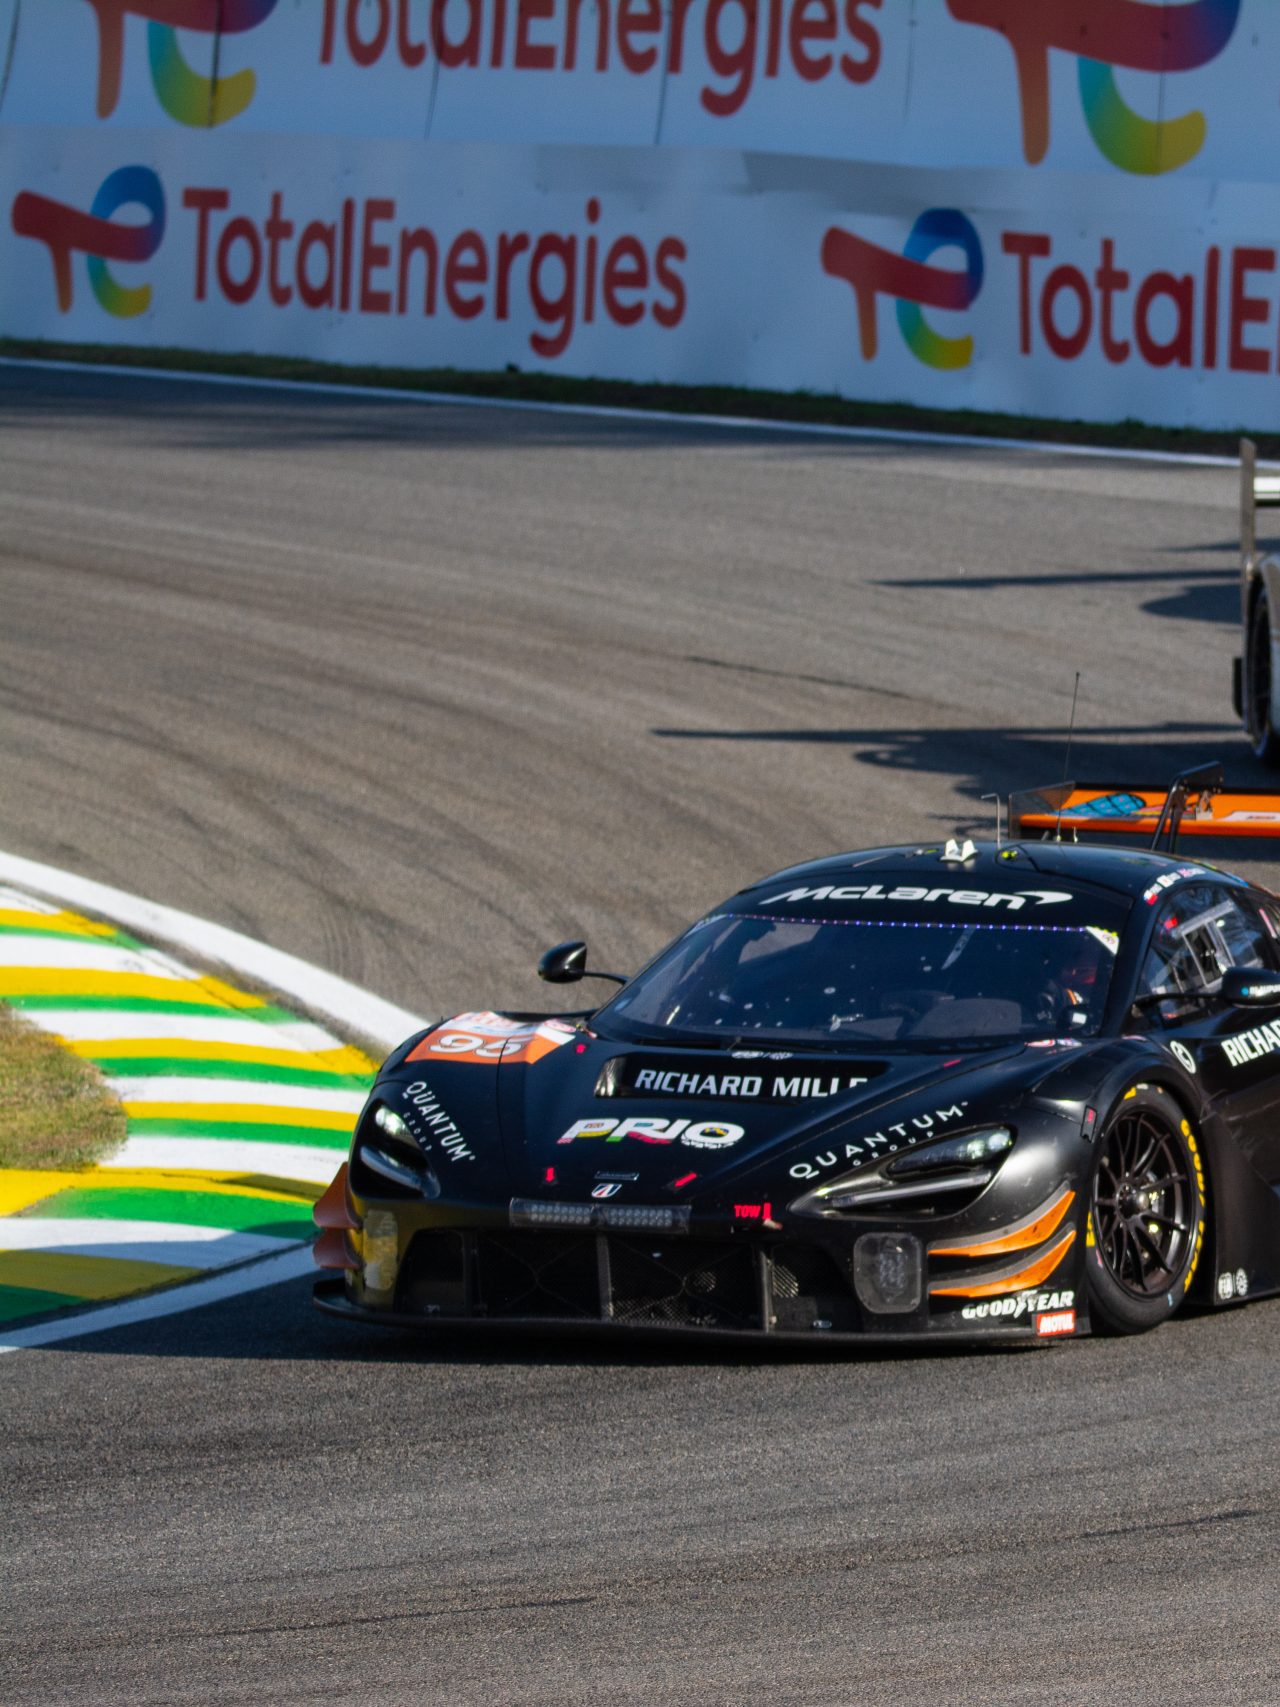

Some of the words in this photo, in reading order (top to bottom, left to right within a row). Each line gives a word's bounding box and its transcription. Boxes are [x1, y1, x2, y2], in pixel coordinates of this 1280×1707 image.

[182, 187, 688, 359] TotalEnergies
[758, 884, 1028, 910] McLaren
[430, 1034, 533, 1058] 95
[634, 1068, 762, 1097] RICHARD
[557, 1117, 746, 1149] PRIO
[852, 1131, 935, 1167] GROUP
[734, 1205, 761, 1219] TOW
[962, 1290, 1075, 1320] GOODYEAR
[1039, 1312, 1075, 1334] MOTUL
